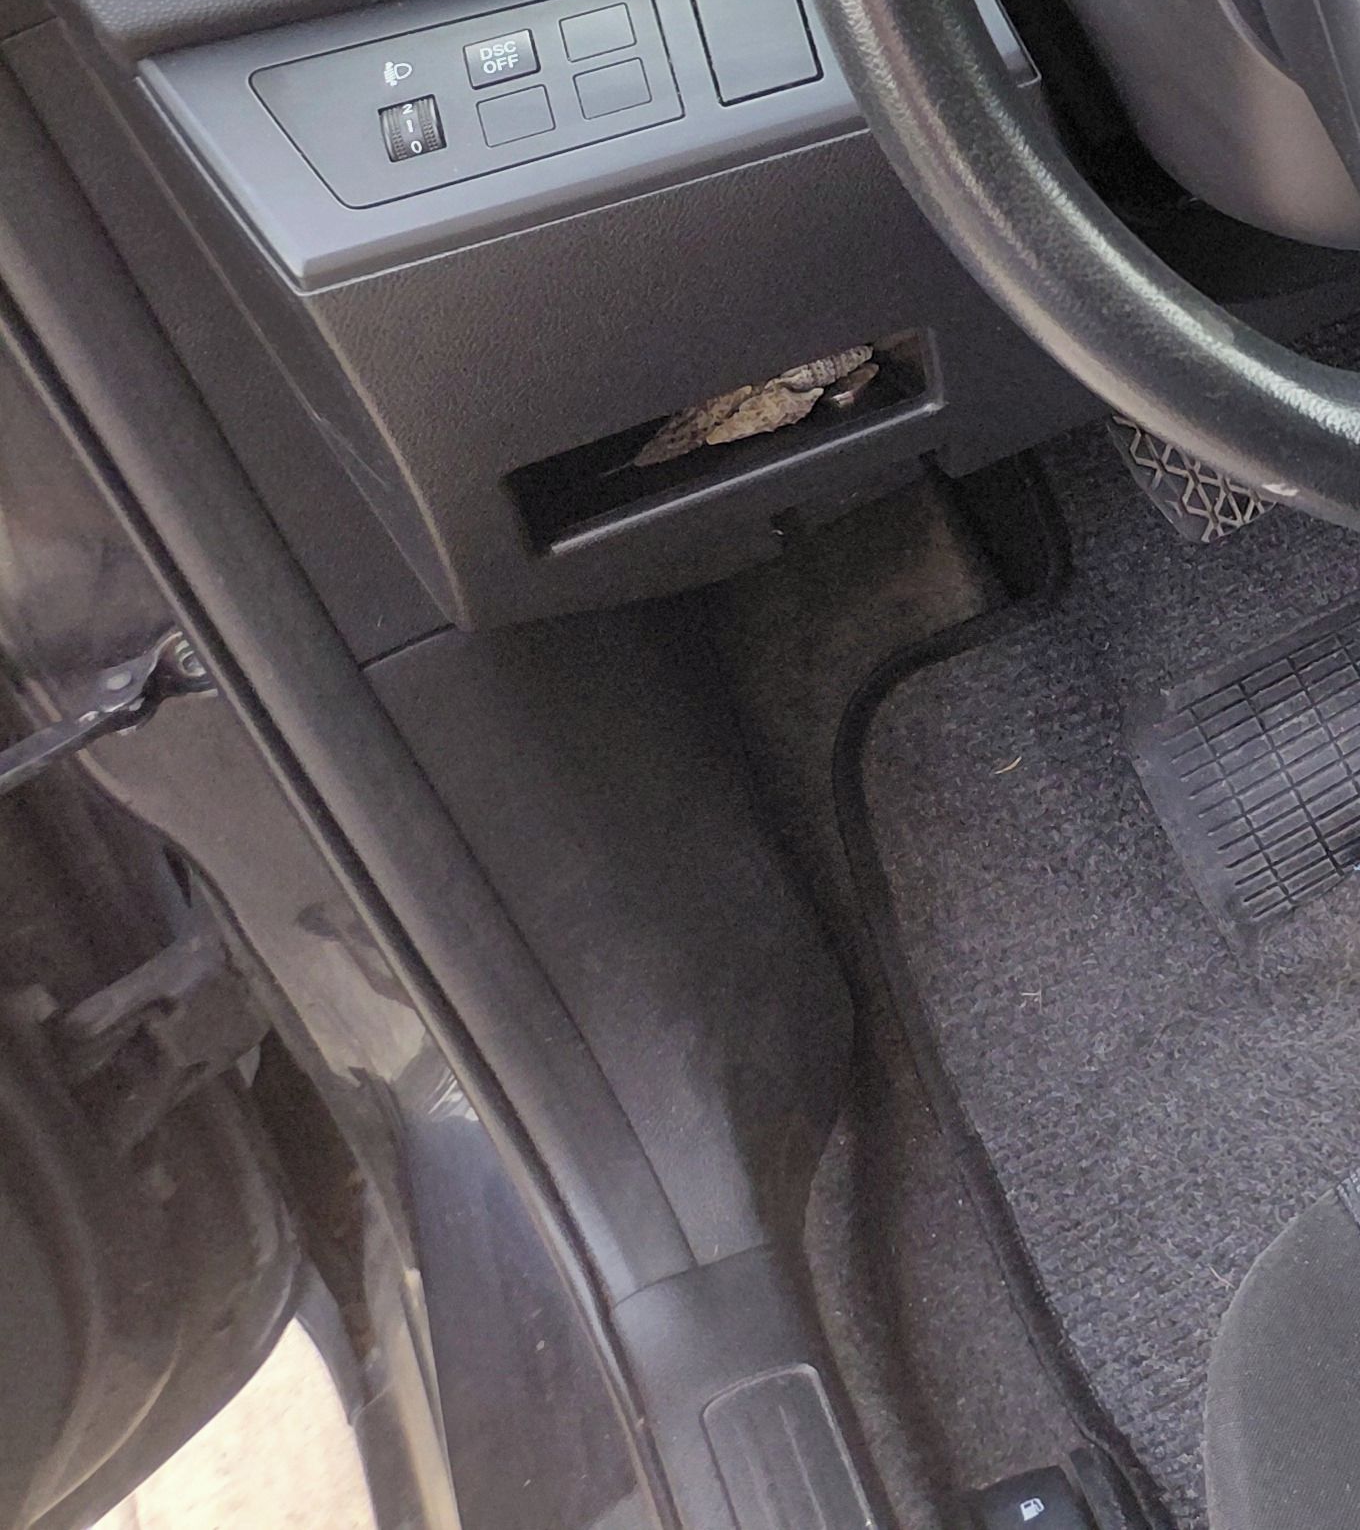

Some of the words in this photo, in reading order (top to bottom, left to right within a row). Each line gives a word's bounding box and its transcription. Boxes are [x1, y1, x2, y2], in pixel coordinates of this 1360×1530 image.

[478, 40, 517, 61] DSC
[483, 53, 519, 74] OFF
[402, 102, 414, 115] 2
[410, 141, 423, 154] 0
